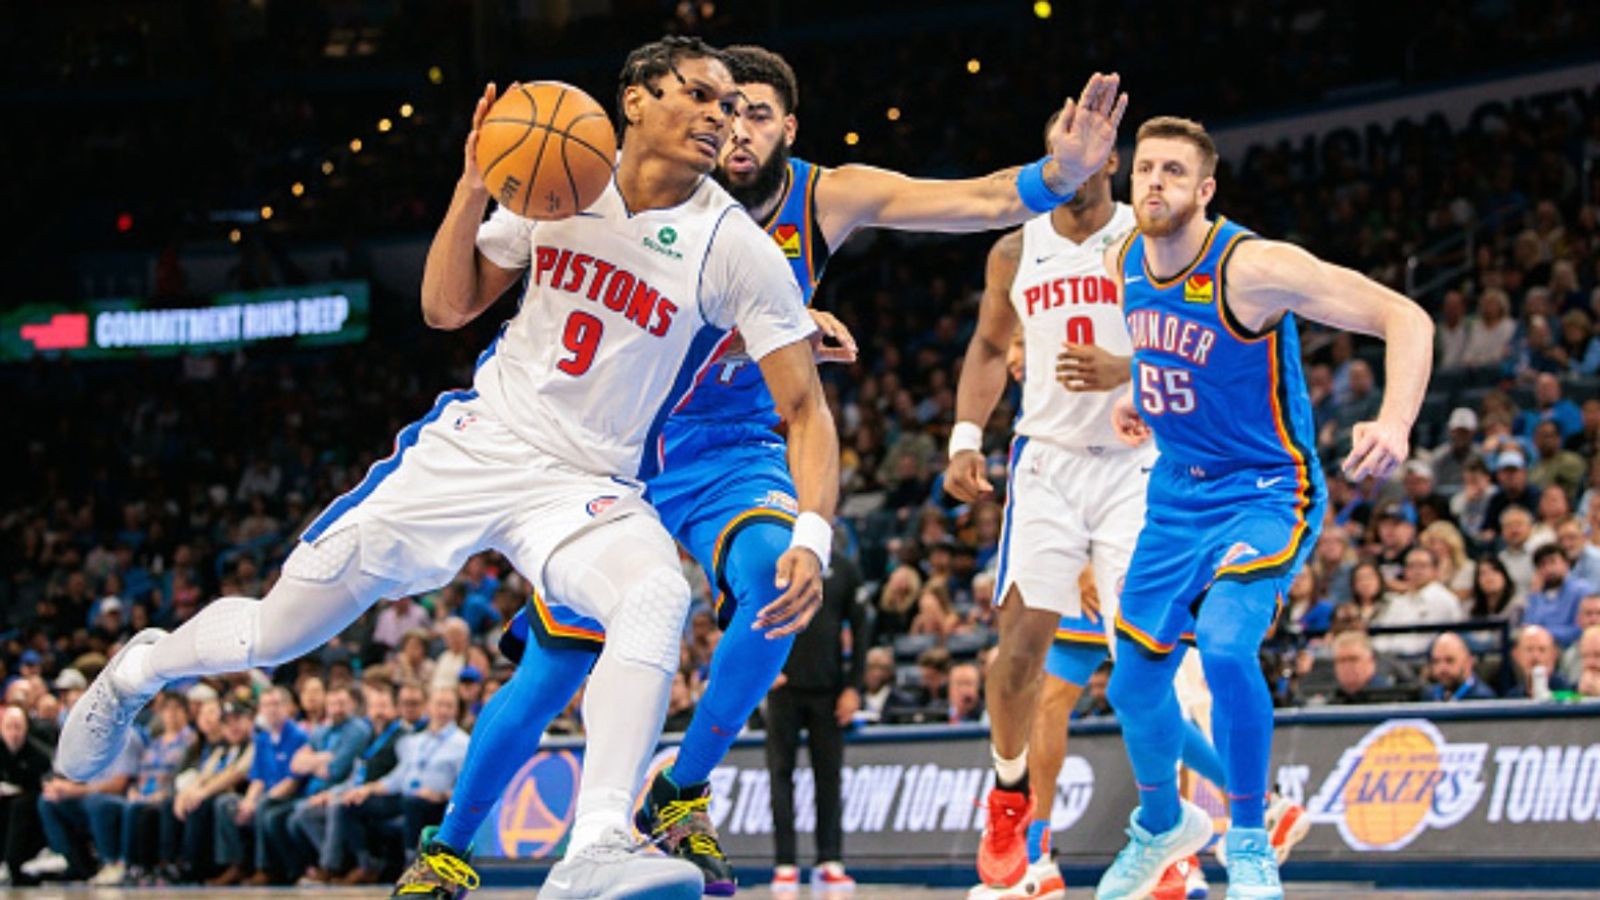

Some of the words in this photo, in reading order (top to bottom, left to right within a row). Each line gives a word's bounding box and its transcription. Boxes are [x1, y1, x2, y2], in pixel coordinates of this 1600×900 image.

[95, 304, 242, 348] COMMITMENT
[297, 295, 349, 334] DEEP
[536, 245, 679, 338] PISTONS
[556, 309, 604, 377] 9
[1139, 361, 1196, 416] 55
[893, 762, 983, 832] 10PM
[1322, 754, 1474, 817] LAKERS
